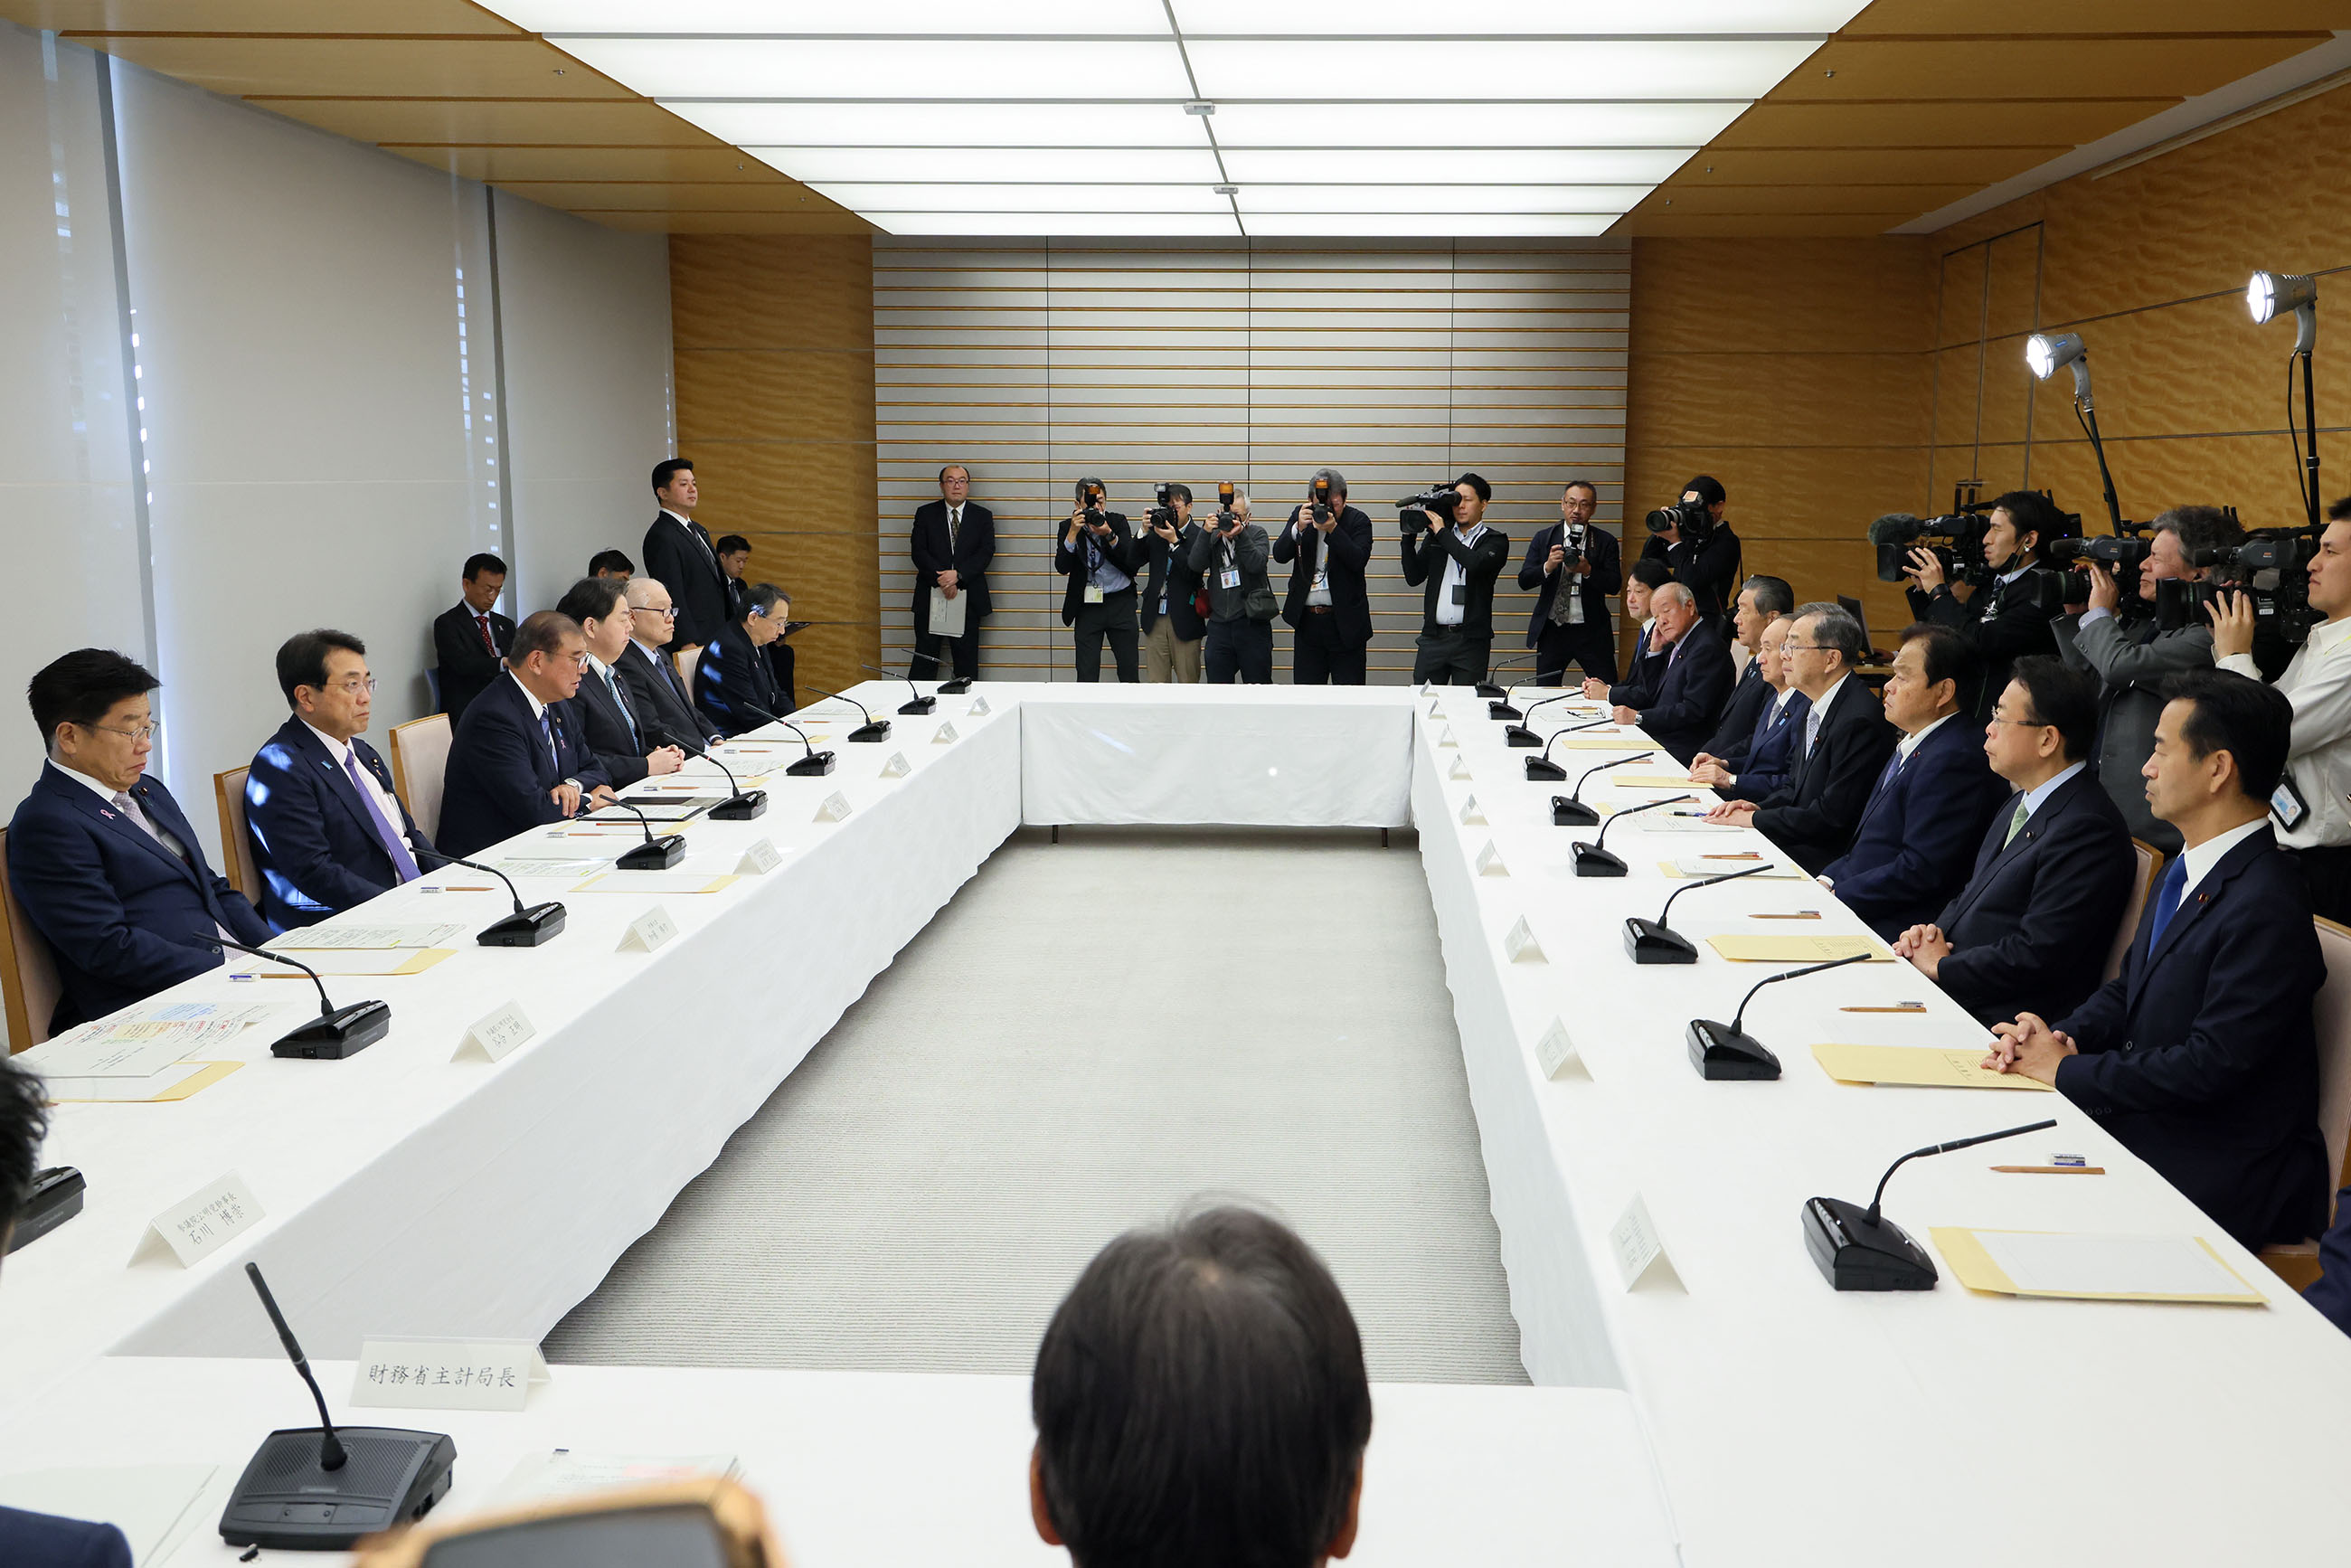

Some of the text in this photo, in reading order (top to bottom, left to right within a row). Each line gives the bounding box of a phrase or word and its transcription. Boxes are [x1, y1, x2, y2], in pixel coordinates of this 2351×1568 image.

[188, 1223, 215, 1245] 石川
[368, 1363, 516, 1388] 財務省主計局長
